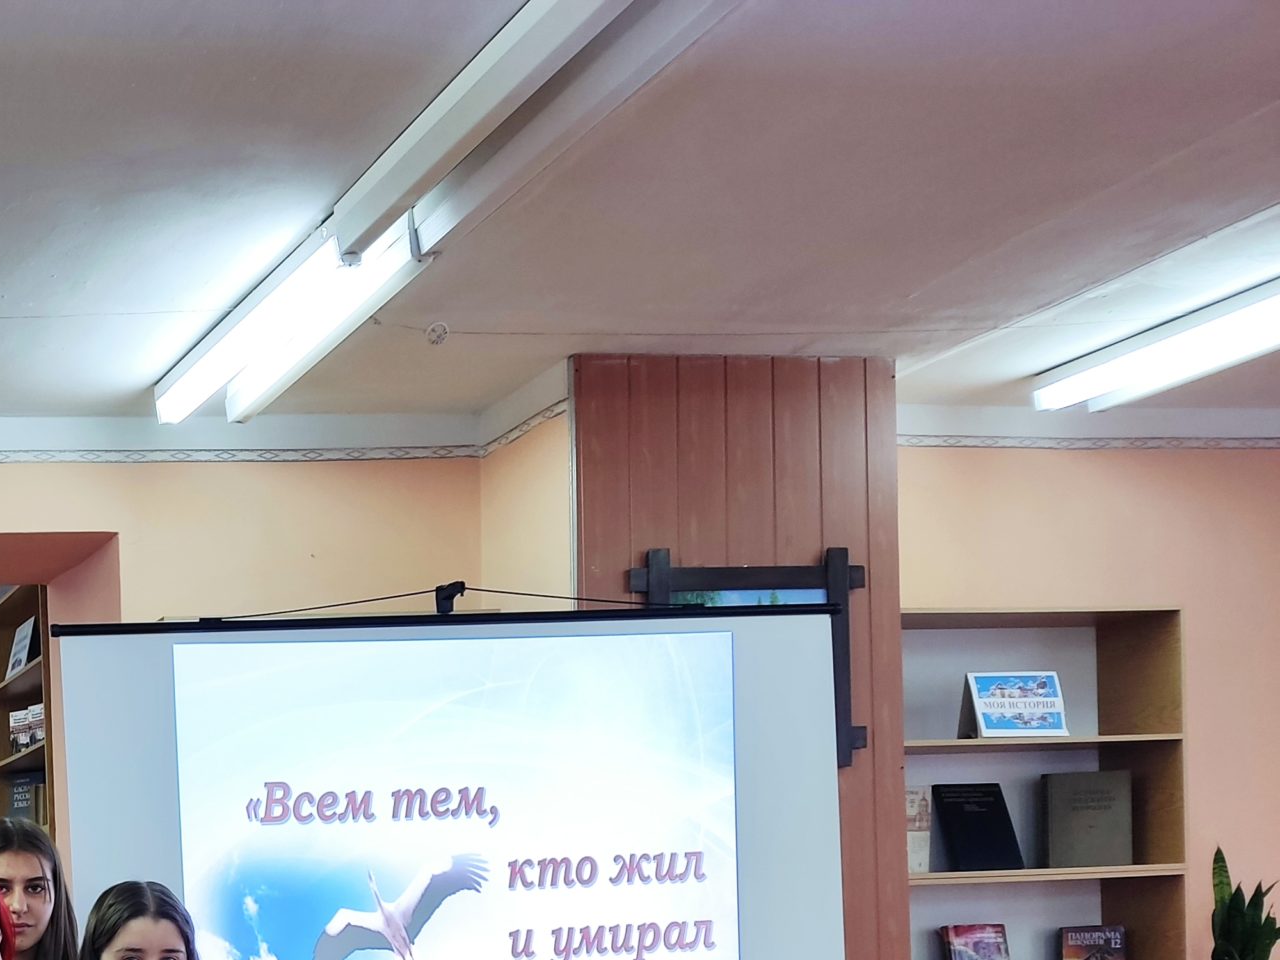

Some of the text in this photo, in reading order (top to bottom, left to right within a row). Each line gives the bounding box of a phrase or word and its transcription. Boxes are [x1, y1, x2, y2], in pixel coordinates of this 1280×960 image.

[983, 700, 1056, 709] МОЯ ИСТОРИЯ
[245, 781, 500, 828] «Всем тем,
[508, 851, 706, 889] кто жил
[508, 929, 535, 959] и
